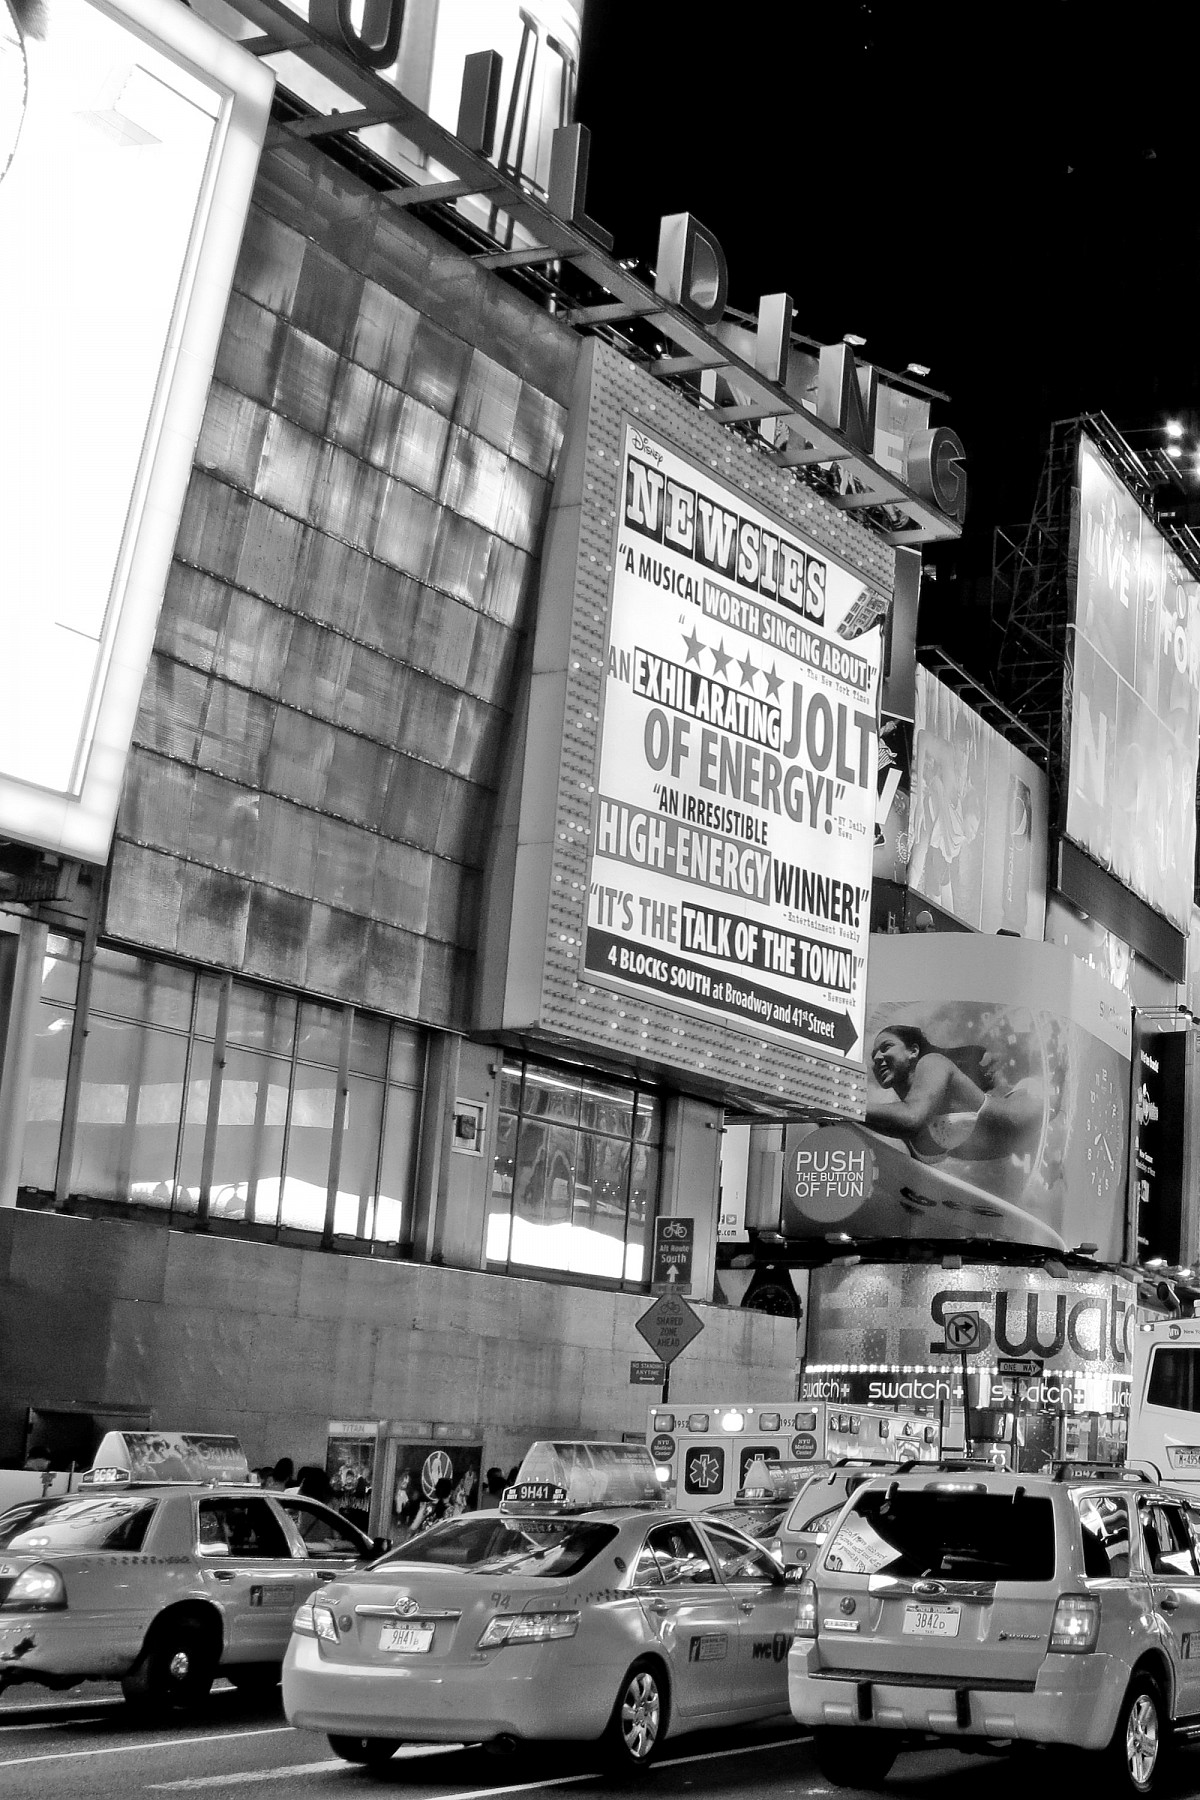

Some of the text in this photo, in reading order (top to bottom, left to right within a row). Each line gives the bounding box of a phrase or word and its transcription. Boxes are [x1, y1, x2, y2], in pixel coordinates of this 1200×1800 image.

[627, 459, 827, 619] NEWSIES
[639, 552, 701, 607] MUSICAL
[705, 582, 759, 638] WORTH
[762, 612, 821, 665] SINGING
[822, 643, 877, 691] ABOUT!"
[608, 645, 877, 789] AN EXHILARATING JOLT
[644, 708, 847, 835] OF ENERGY!"
[682, 798, 769, 846] IRRESISTIBLE
[599, 800, 869, 928] HIGH-ENERGY WINNER!"
[639, 897, 679, 944] THE
[682, 908, 732, 959] TALK
[735, 922, 759, 964] OF
[762, 929, 796, 976] THE
[800, 940, 865, 991] TOWN!"
[607, 945, 835, 1039] 4 BLOCKS SOUTH at Broadway and 41st Street
[796, 1150, 865, 1172] PUSH
[796, 1172, 864, 1182] THE BUTTON
[795, 1182, 864, 1198] OF FUN
[661, 1253, 687, 1264] South
[656, 1317, 684, 1327] SHARED
[660, 1327, 678, 1337] ZONE
[657, 1338, 680, 1348] AHEAD
[636, 1369, 660, 1377] ANYTIME
[1003, 1363, 1038, 1374] ONE WAY
[802, 1380, 841, 1399] swatch
[868, 1380, 951, 1401] swatch
[343, 1425, 365, 1433] TITAN
[674, 1420, 690, 1429] 1952
[780, 1418, 796, 1428] 1952
[520, 1486, 549, 1499] 9H41
[752, 1642, 772, 1660] NYC
